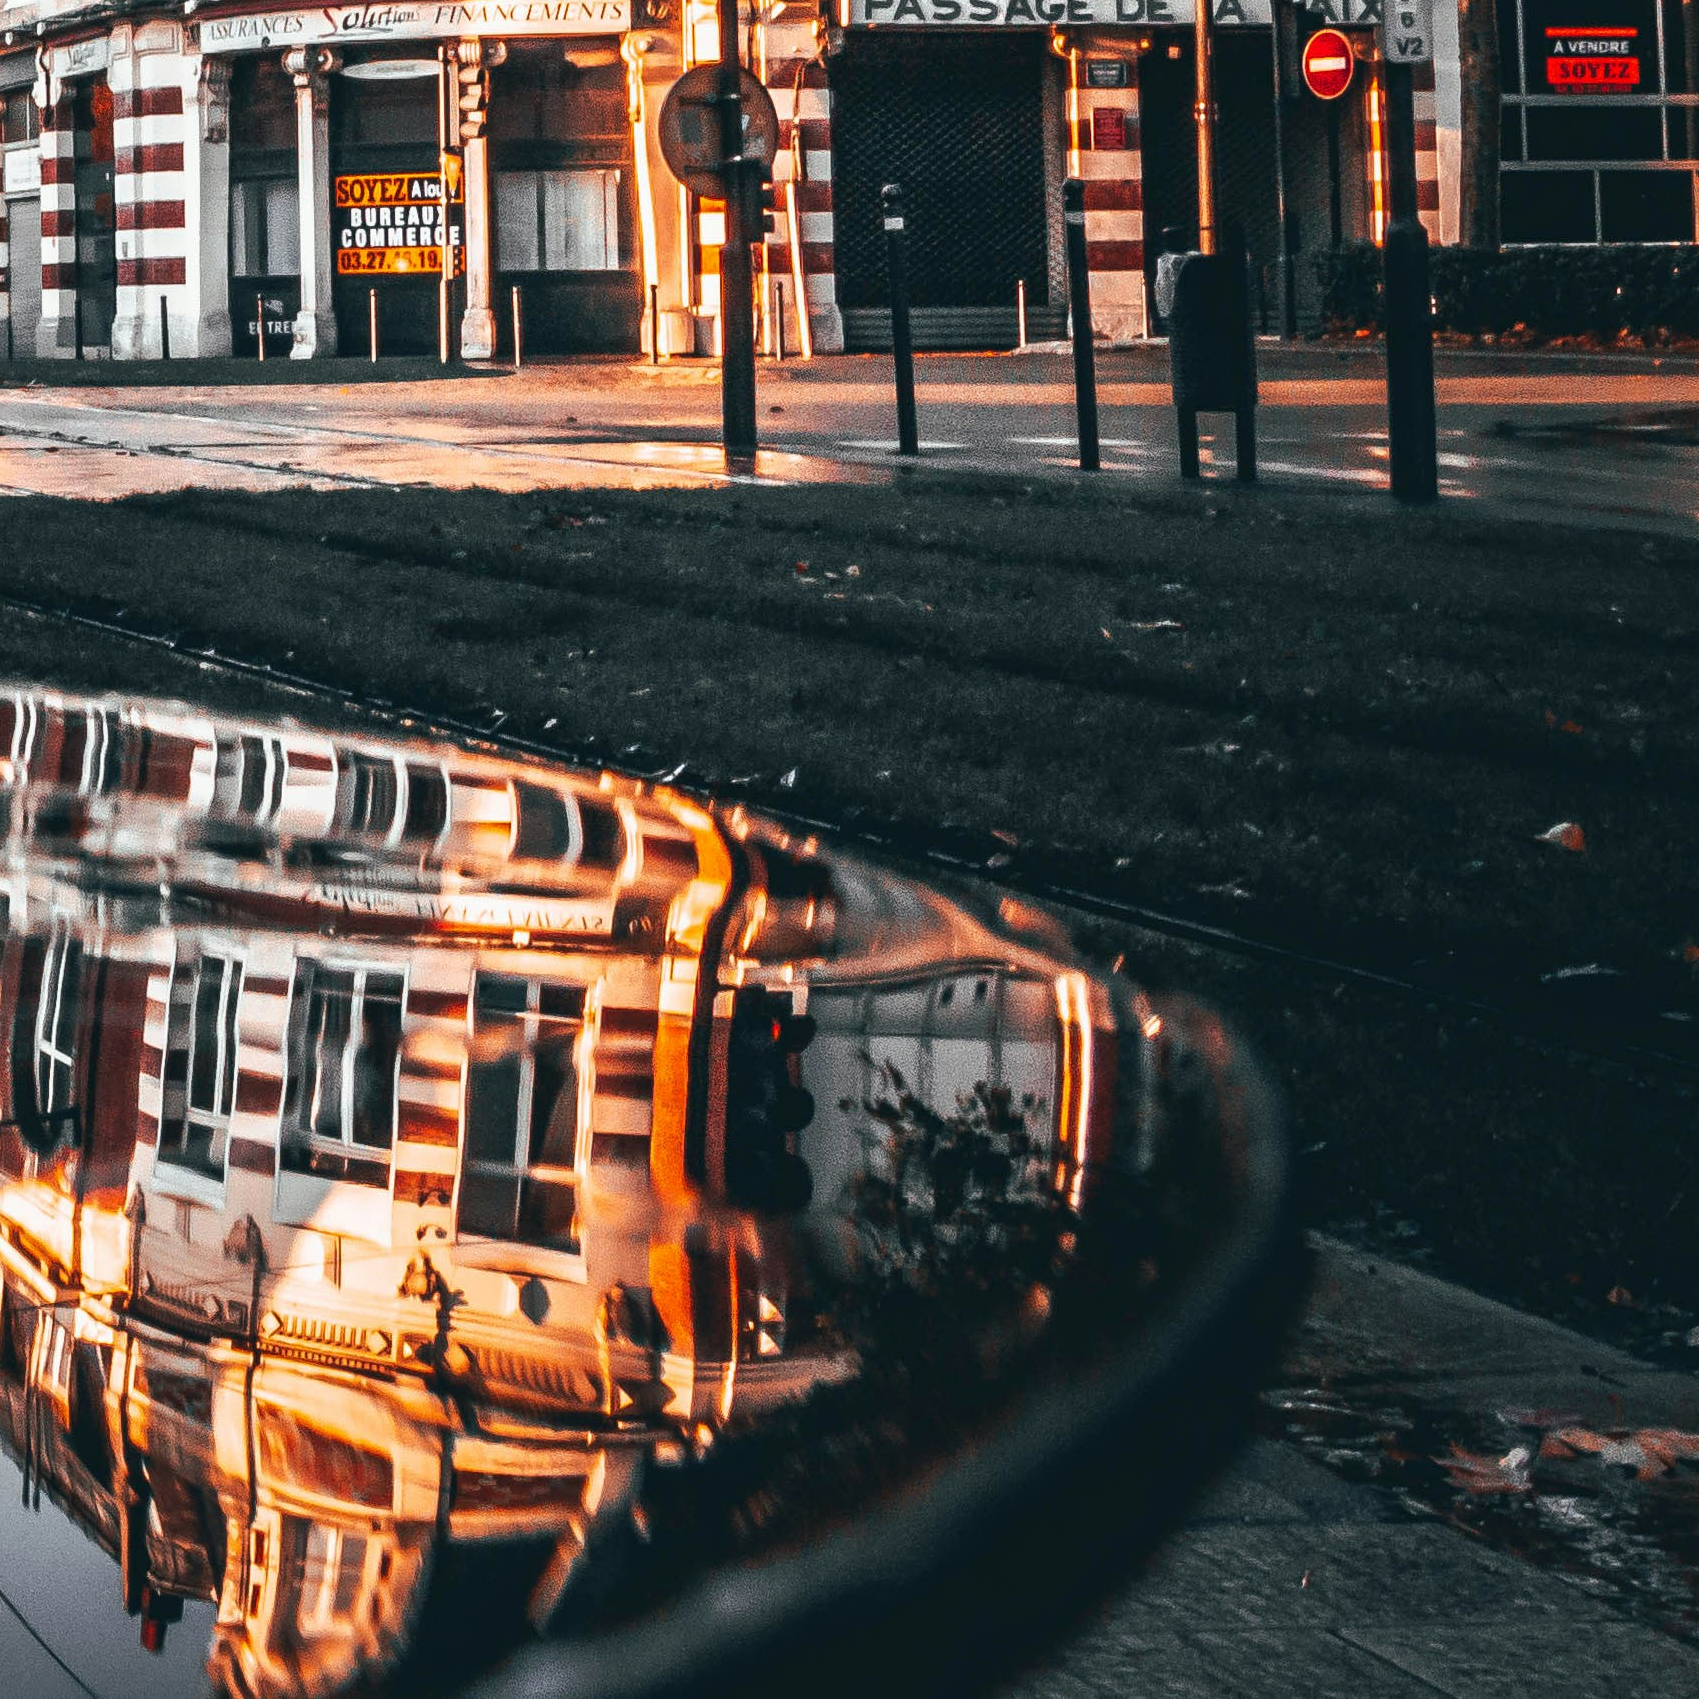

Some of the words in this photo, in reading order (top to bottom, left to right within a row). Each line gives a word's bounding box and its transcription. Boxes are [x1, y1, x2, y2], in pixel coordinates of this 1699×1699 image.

[208, 14, 302, 43] ASSURANCES
[434, 1, 623, 26] FINANCEMENTS
[1567, 40, 1629, 54] VENDRE
[1559, 62, 1631, 79] SOYEZ
[337, 178, 406, 203] SOYEZ
[411, 180, 422, 198] A
